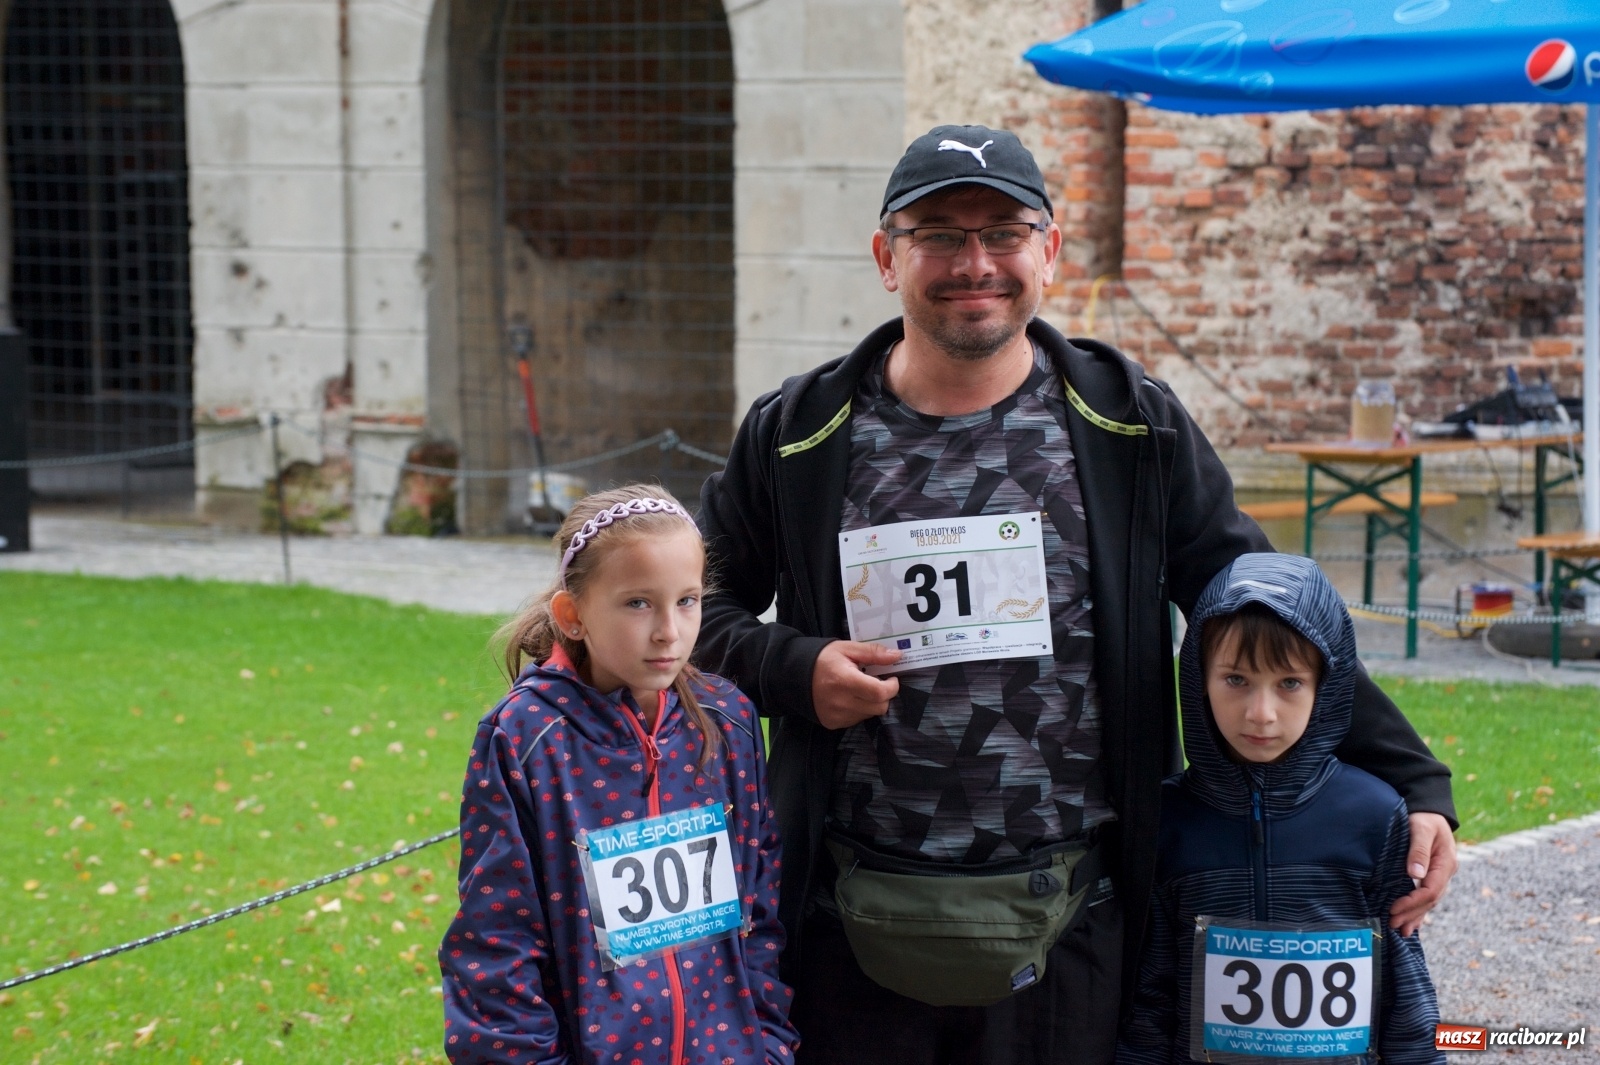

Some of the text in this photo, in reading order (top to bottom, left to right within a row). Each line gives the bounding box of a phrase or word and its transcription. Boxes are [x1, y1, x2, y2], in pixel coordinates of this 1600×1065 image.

[910, 525, 967, 538] BIEG O ZŁOTY KŁOS
[916, 533, 962, 547] 19.09.2021
[903, 560, 972, 623] 31
[594, 812, 722, 854] TIME-SPORT.PL
[611, 836, 718, 924] 307
[614, 904, 736, 943] NUMER ZWROTNY NA MECIE
[633, 919, 726, 950] WWW.TIME-SPORT.PL
[1212, 933, 1368, 955] TIME-SPORT.PL
[1221, 959, 1357, 1029] 308
[1211, 1027, 1364, 1042] NUMER ZWROTNY NA MECIE
[1229, 1040, 1349, 1054] WWW.TIME-SPORT.PL
